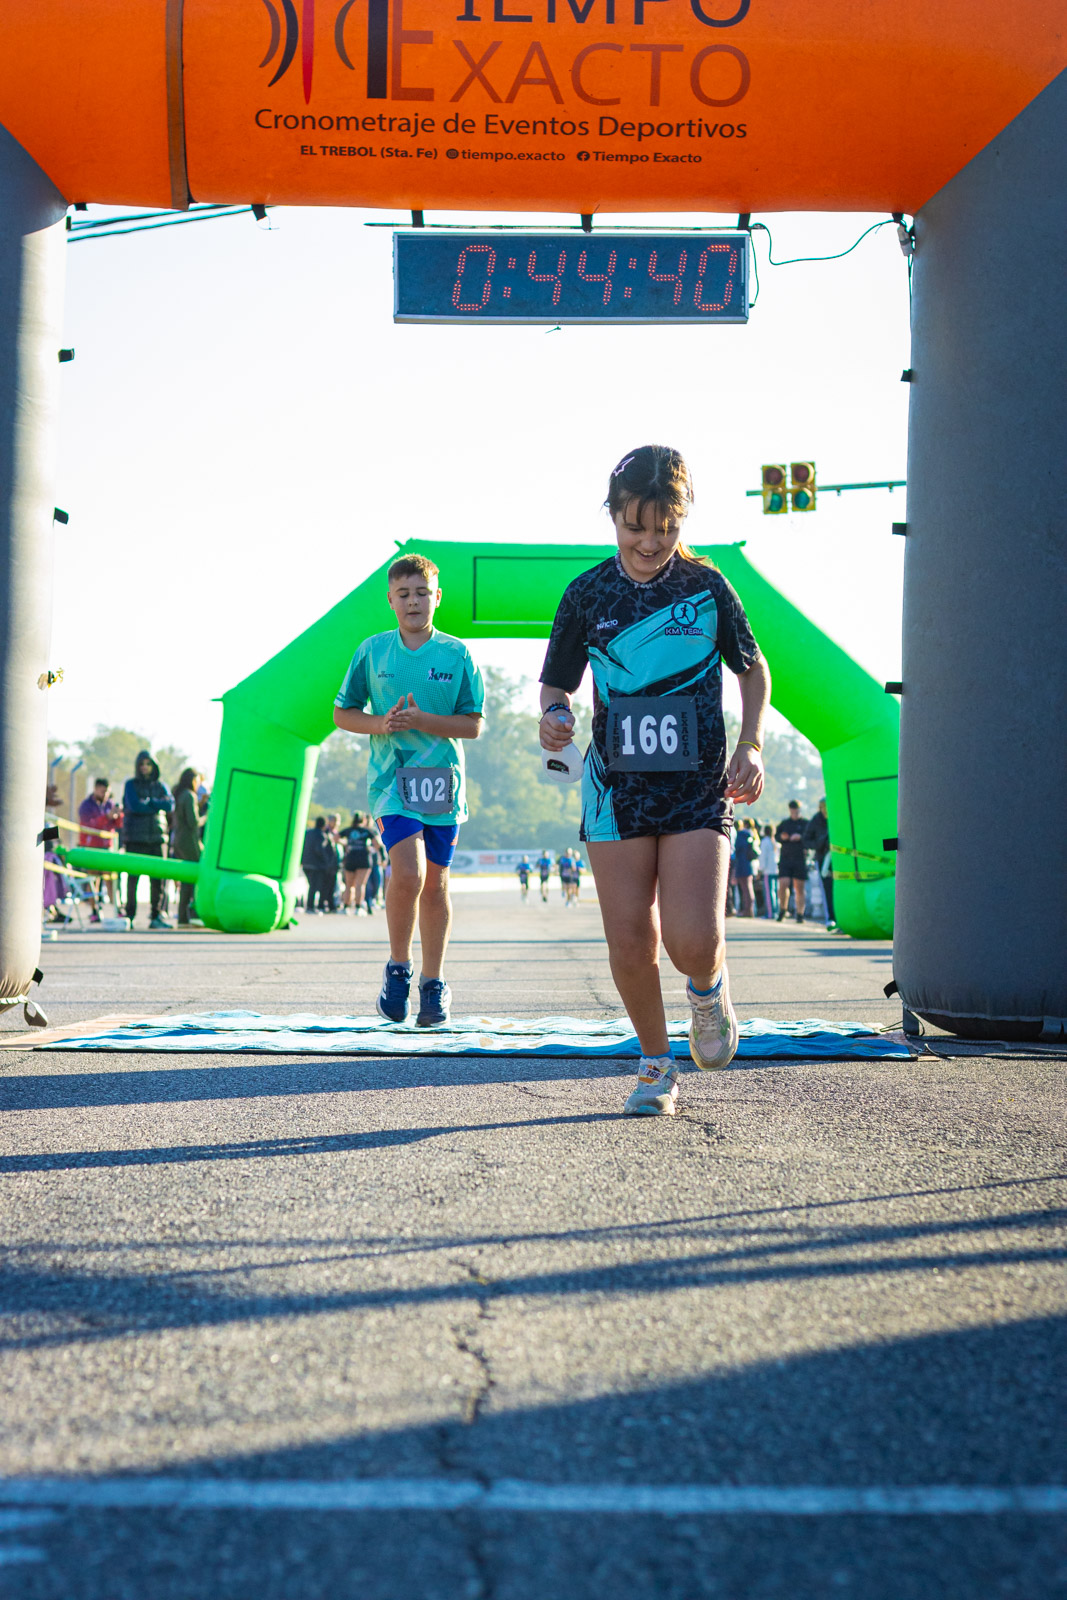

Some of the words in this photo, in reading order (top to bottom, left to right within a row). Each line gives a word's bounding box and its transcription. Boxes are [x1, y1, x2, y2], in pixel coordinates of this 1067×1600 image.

[391, 0, 751, 108] EXACTO
[254, 108, 436, 138] Cronometraje
[442, 112, 477, 134] de
[484, 113, 590, 137] Eventos
[598, 115, 748, 142] Deportivos
[300, 145, 318, 156] EL
[319, 145, 377, 158] TREBOL
[380, 146, 413, 159] (Sta.
[416, 147, 438, 160] Fe)
[461, 148, 566, 162] tiempo.exacto
[592, 150, 650, 165] Tiempo
[653, 151, 703, 163] Exacto
[451, 244, 738, 312] 0:44:40
[621, 714, 679, 755] 166
[680, 711, 690, 757] EXACTO
[408, 777, 446, 803] 102
